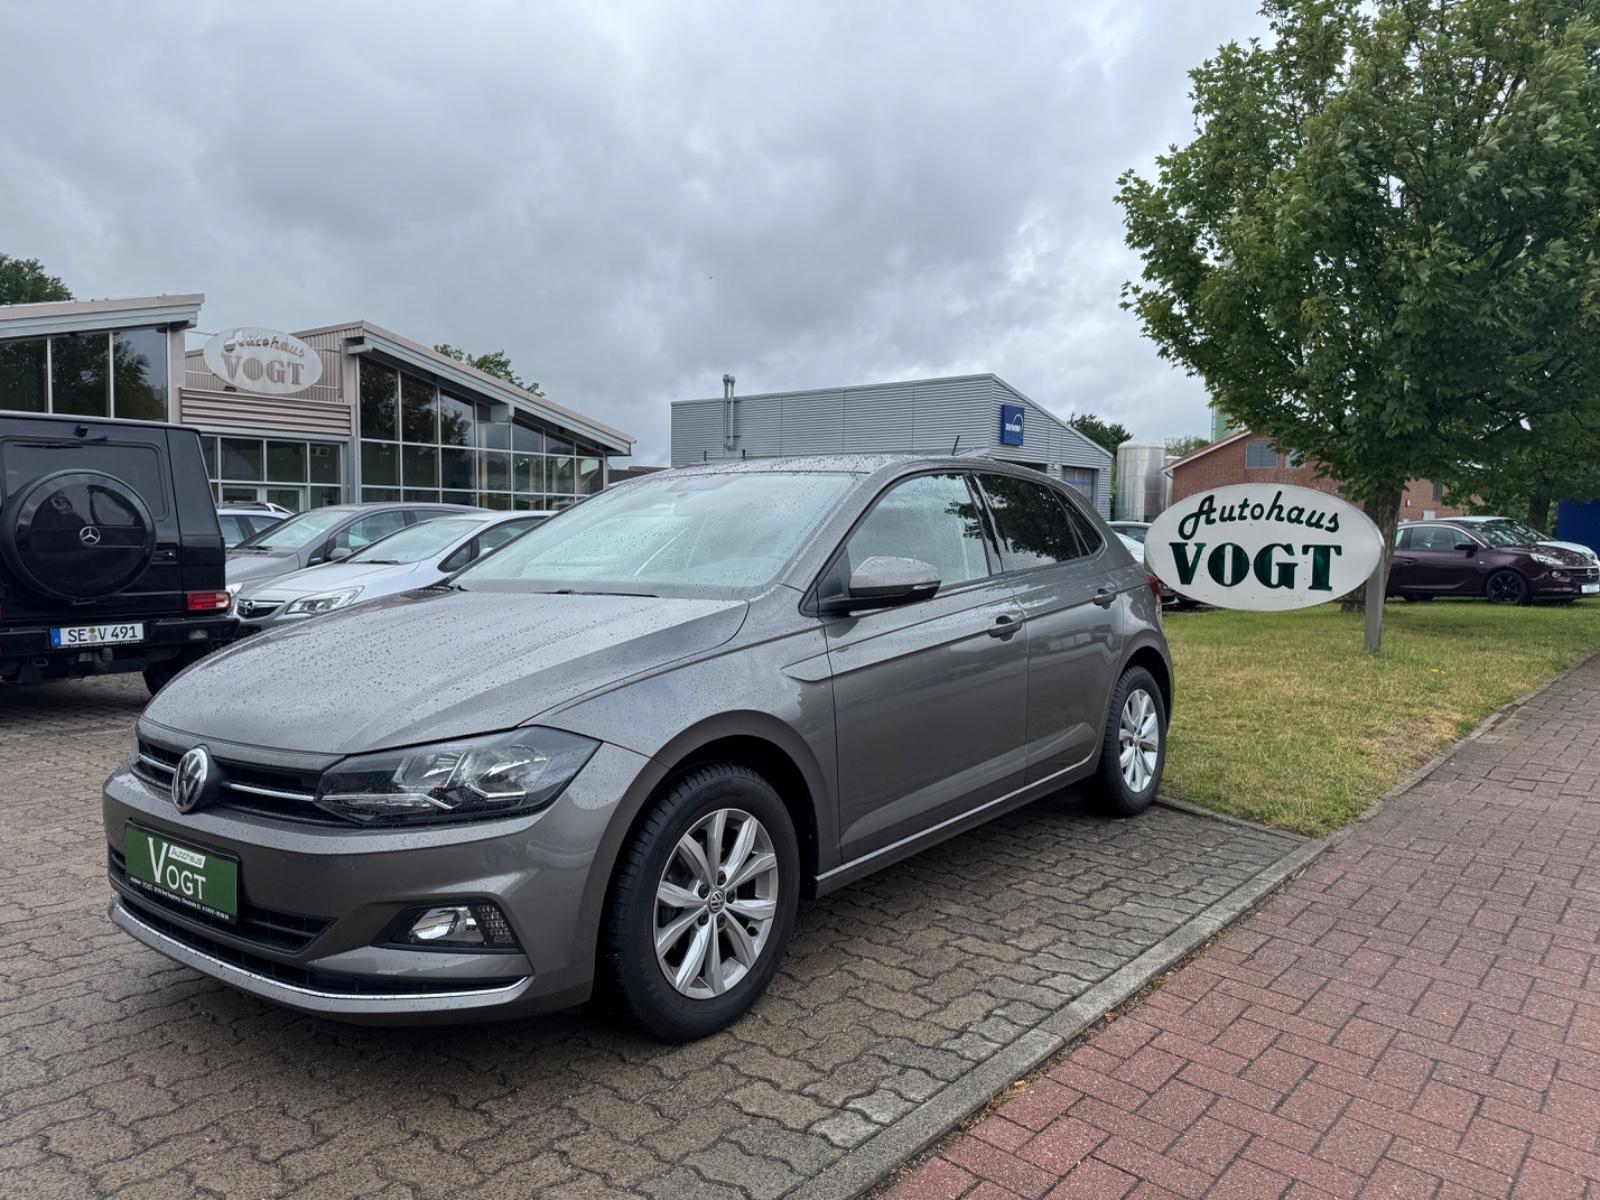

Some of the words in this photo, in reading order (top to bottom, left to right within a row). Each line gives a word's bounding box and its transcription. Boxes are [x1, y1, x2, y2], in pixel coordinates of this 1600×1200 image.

[221, 353, 305, 385] VOGT
[1177, 490, 1340, 540] Autohaus
[1168, 542, 1342, 591] VOGT
[67, 628, 88, 643] SE
[97, 627, 107, 641] V
[110, 625, 138, 640] 491
[147, 836, 207, 901] VOGT
